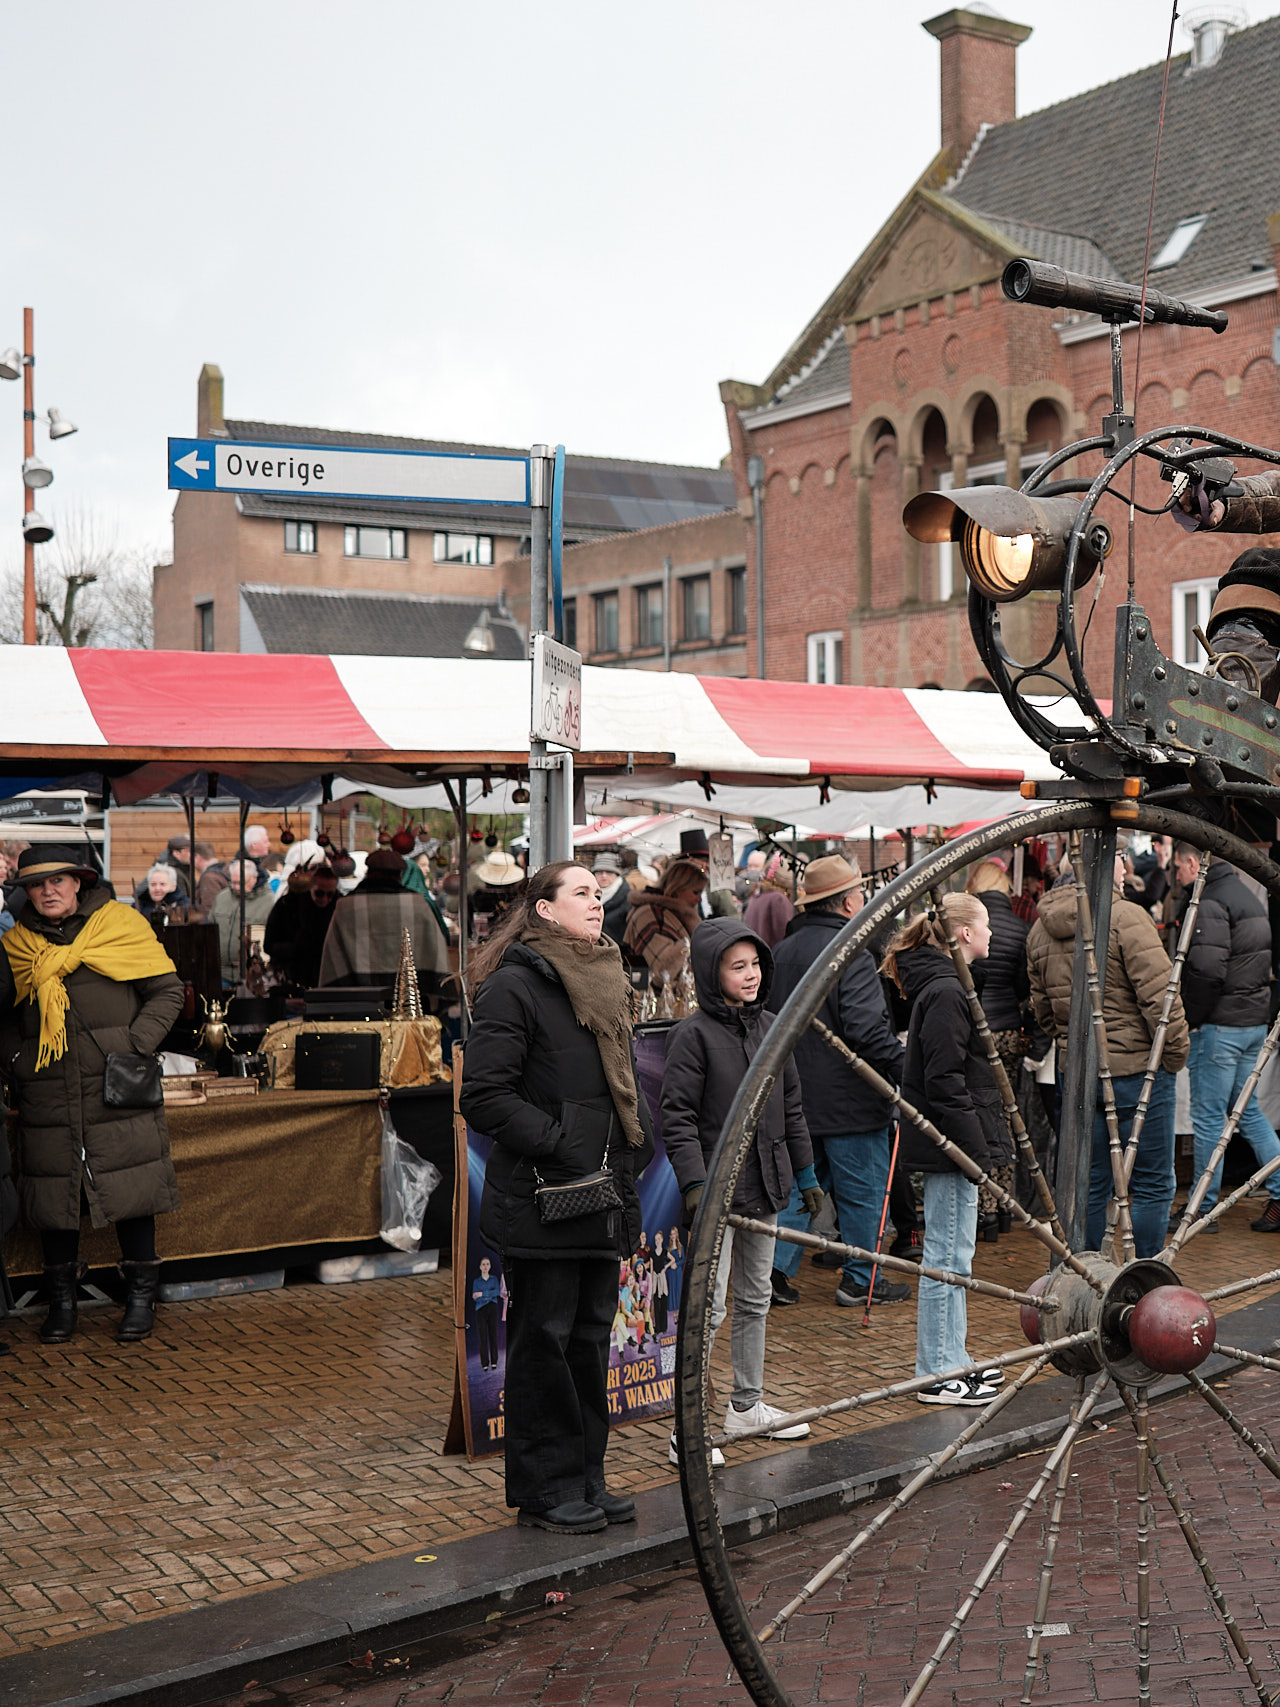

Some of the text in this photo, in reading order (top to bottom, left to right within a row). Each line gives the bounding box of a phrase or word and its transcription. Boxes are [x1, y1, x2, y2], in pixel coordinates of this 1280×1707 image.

[227, 453, 325, 487] Overige
[545, 650, 581, 681] uitgezonderd
[985, 823, 1011, 840] HOSE
[1008, 812, 1038, 829] STEAM
[897, 884, 913, 900] PN
[871, 902, 893, 923] BAR
[852, 918, 876, 943] MAX
[623, 1358, 657, 1385] 2025
